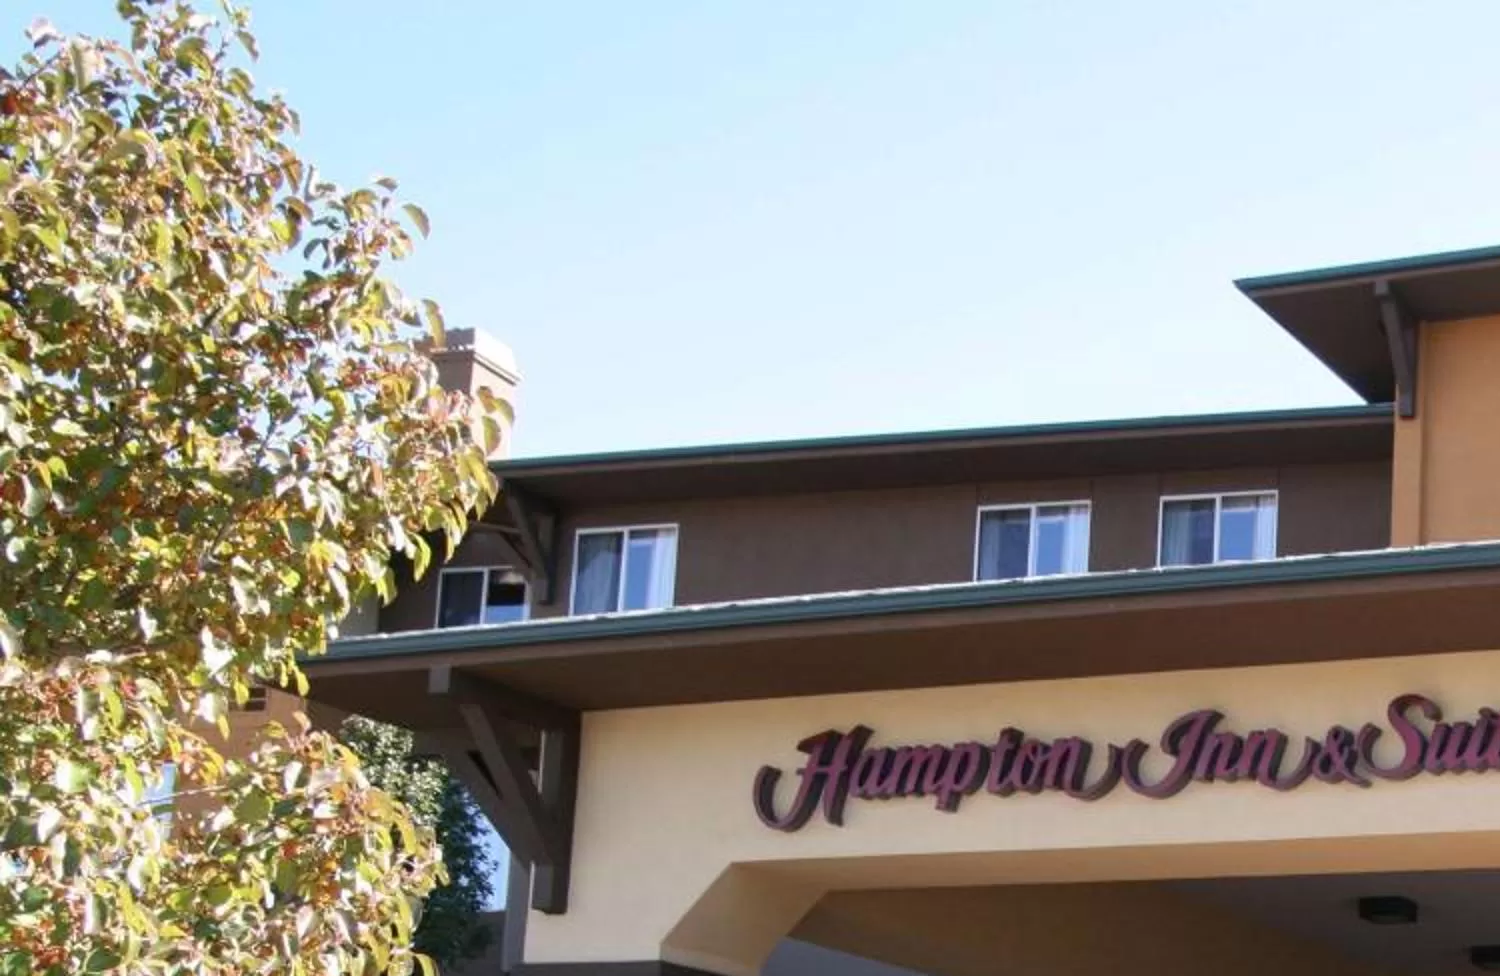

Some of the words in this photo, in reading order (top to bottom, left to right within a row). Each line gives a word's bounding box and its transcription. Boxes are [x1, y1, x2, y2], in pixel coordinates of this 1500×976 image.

[753, 724, 1124, 833] Hampton
[1121, 709, 1317, 799] Inn
[1313, 725, 1372, 788] &
